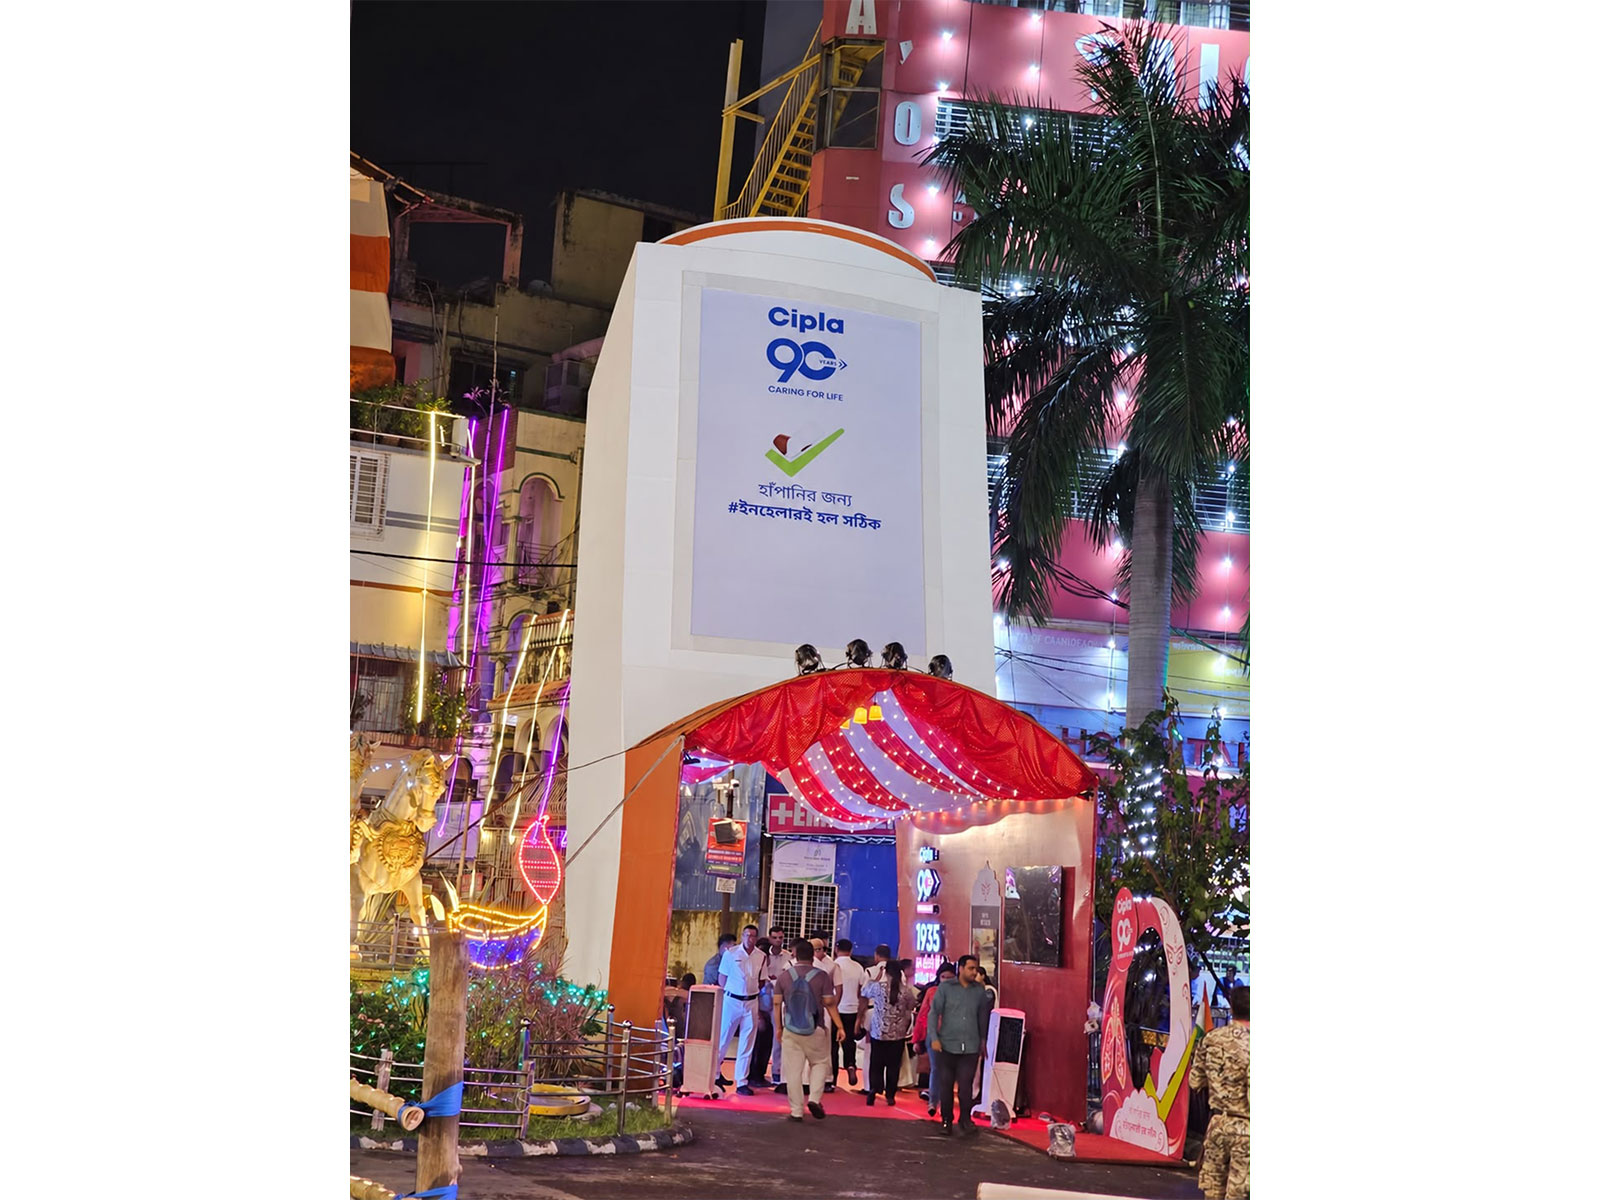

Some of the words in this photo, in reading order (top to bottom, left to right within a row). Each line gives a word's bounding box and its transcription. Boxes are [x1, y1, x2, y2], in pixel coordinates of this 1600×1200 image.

[768, 306, 844, 334] Cipla
[766, 338, 837, 383] 90
[819, 359, 837, 367] YEARS
[768, 385, 805, 397] CARING
[806, 389, 825, 399] FOR
[826, 393, 844, 402] LIFE
[758, 481, 817, 502] হাঁপানির
[821, 491, 853, 507] জন্য
[728, 499, 813, 522] #ইনহেলারই
[816, 511, 839, 525] হল
[842, 512, 882, 530] সঠিক
[916, 922, 940, 953] 1935
